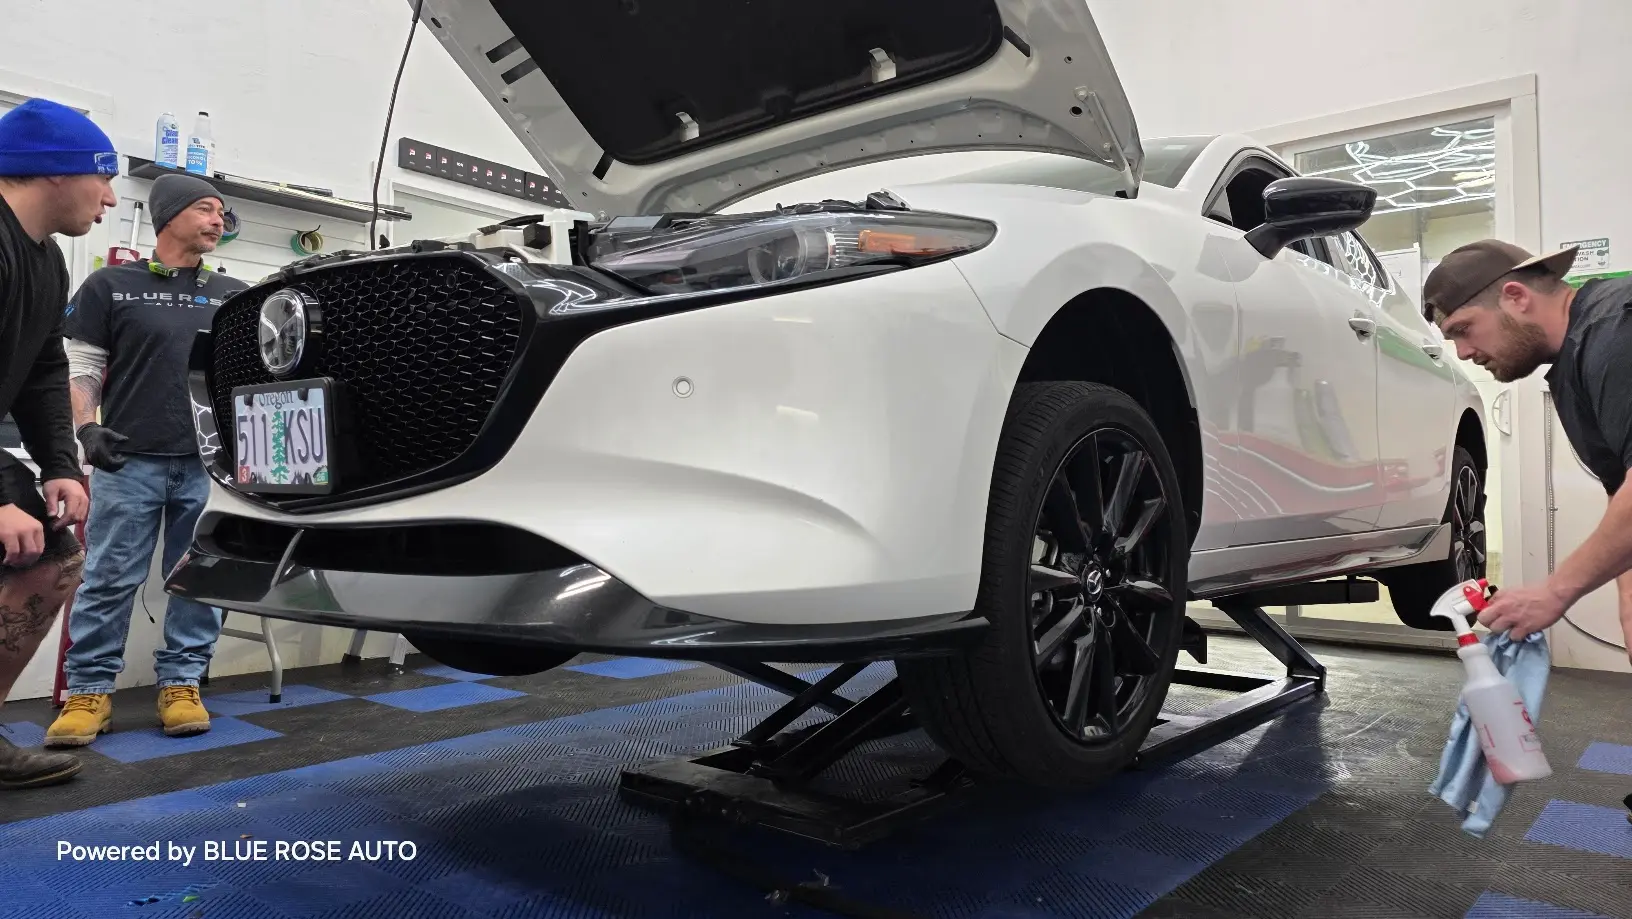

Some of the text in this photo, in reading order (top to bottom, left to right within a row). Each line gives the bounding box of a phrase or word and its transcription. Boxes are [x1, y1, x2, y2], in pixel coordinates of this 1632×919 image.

[112, 292, 223, 307] BLUE ROS
[259, 391, 294, 409] Oregon
[238, 407, 324, 467] 511 KSU
